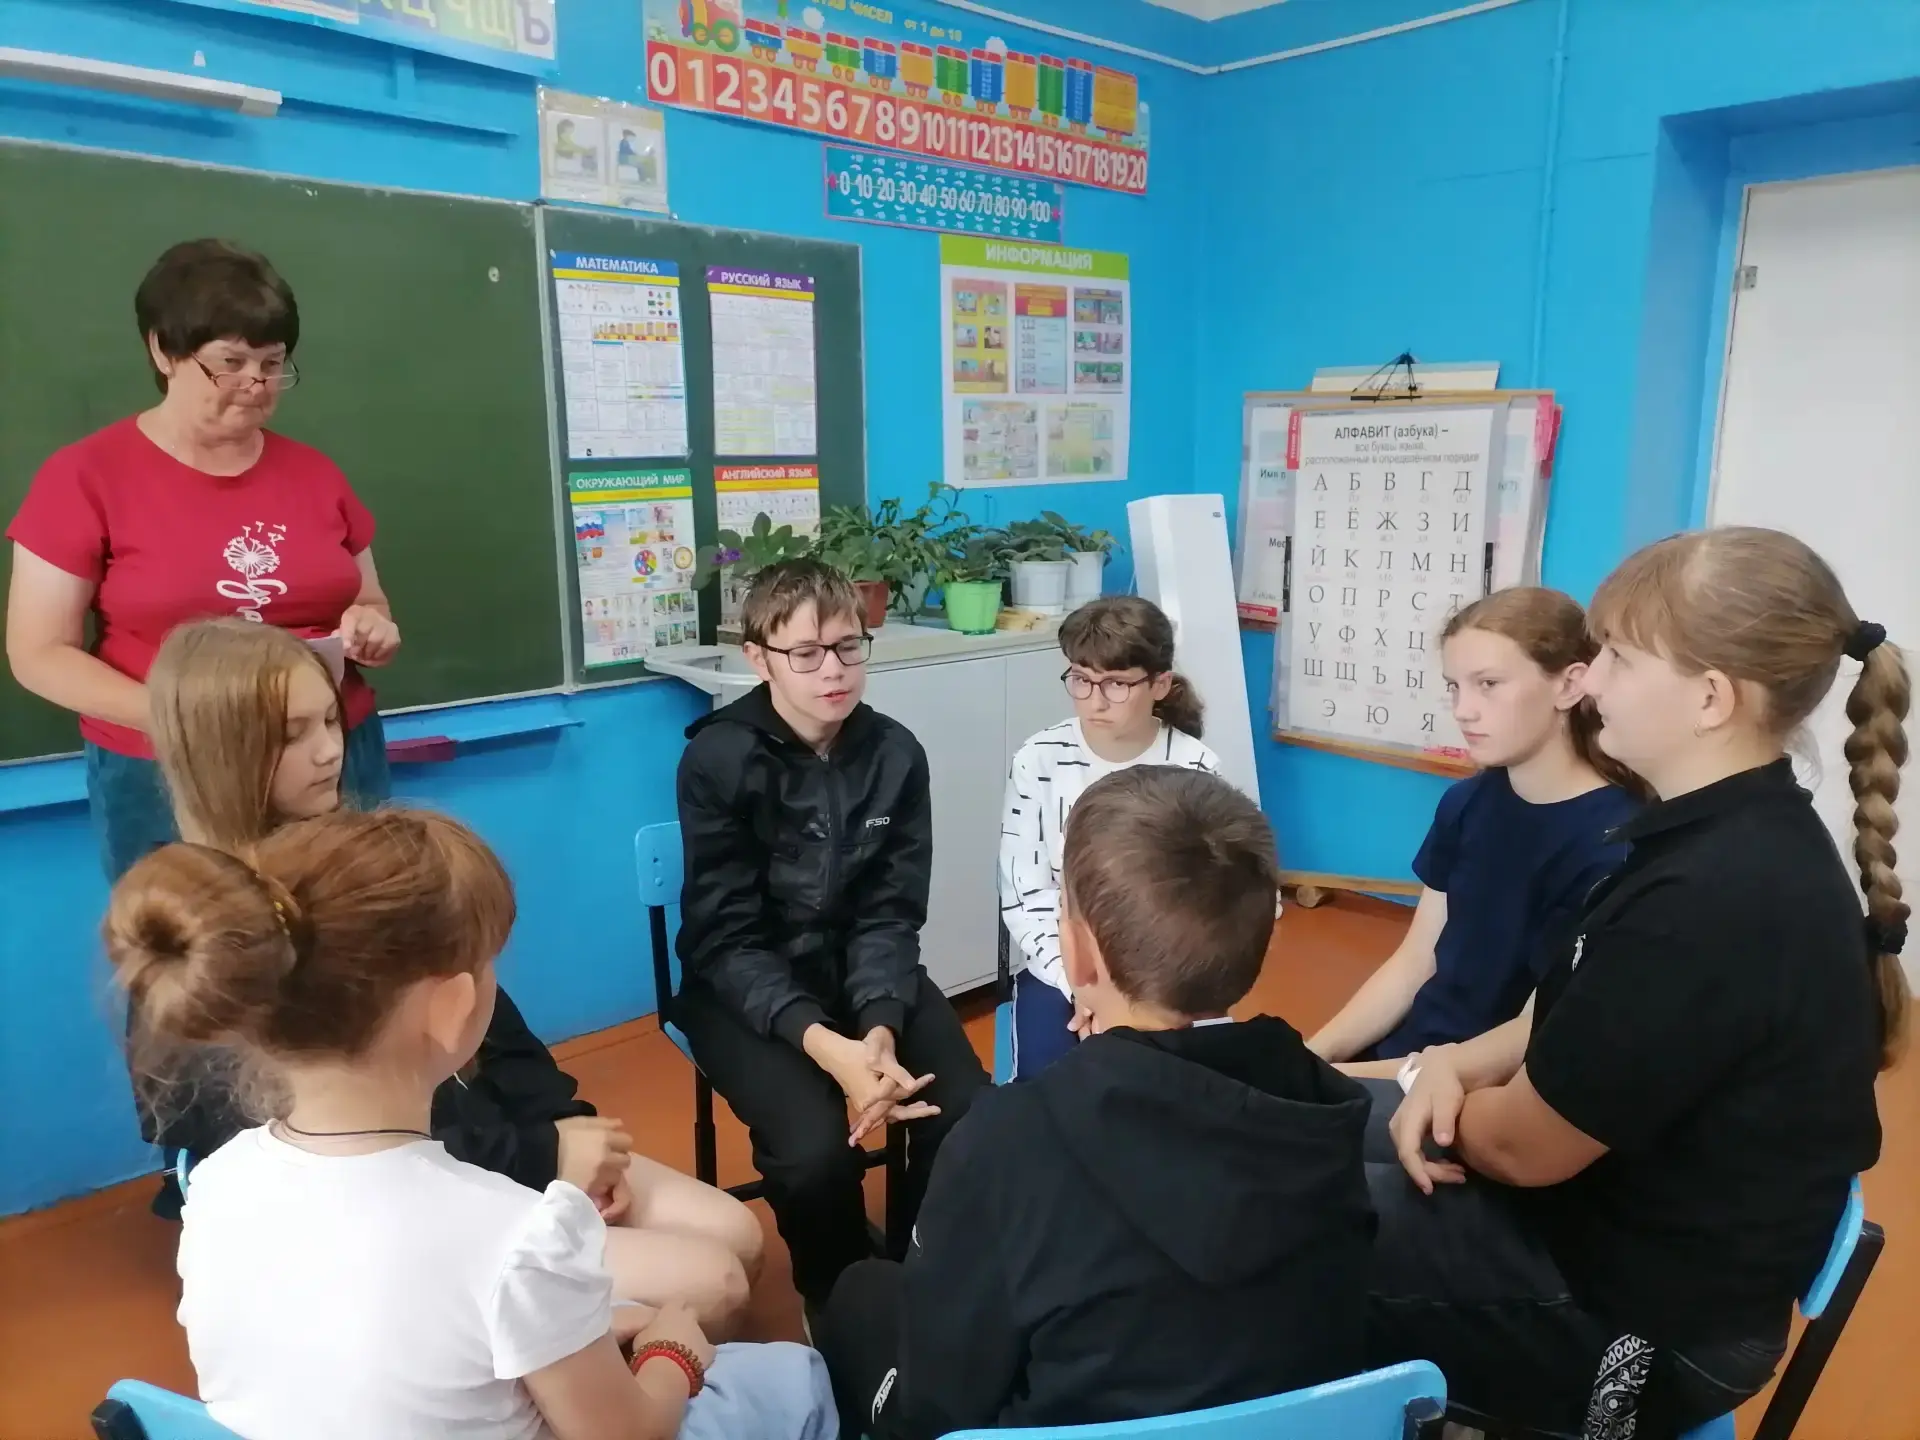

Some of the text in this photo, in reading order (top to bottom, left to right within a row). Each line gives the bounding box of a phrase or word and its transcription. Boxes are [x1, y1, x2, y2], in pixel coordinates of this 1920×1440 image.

[649, 51, 1147, 189] 0 1 2 3 4 5 6 7 8 9 10 11 12 13 14 15 16 17 18 19 20
[840, 171, 1050, 223] 0 10 20 30 40 50 60 70 80 90 100
[576, 256, 659, 274] МАТЕМАТИКА
[985, 243, 1092, 271] ИНФОРМАЦИЯ
[721, 271, 801, 289] РУССКИЙ ЯЗЫК
[1335, 425, 1391, 439] АЛФАВИТ
[1393, 424, 1438, 440] (азбука)
[576, 473, 685, 489] ОКРУЖАЮЩИЙ МИР
[722, 466, 812, 480] АНГЛИЙСКИЙ ЯЗЫК
[1313, 471, 1472, 495] А Б В Г Д
[1315, 507, 1470, 532] Е Ё Ж З И
[1311, 545, 1468, 572] Й К Л М Н
[1309, 585, 1324, 603] О
[1341, 587, 1357, 606] П
[1377, 589, 1390, 607] Р
[1411, 592, 1427, 611] С
[1309, 622, 1425, 653] У Ф Х Ц
[1303, 658, 1425, 689] Ш Щ Ъ Ы
[1322, 699, 1436, 732] Э Ю Я
